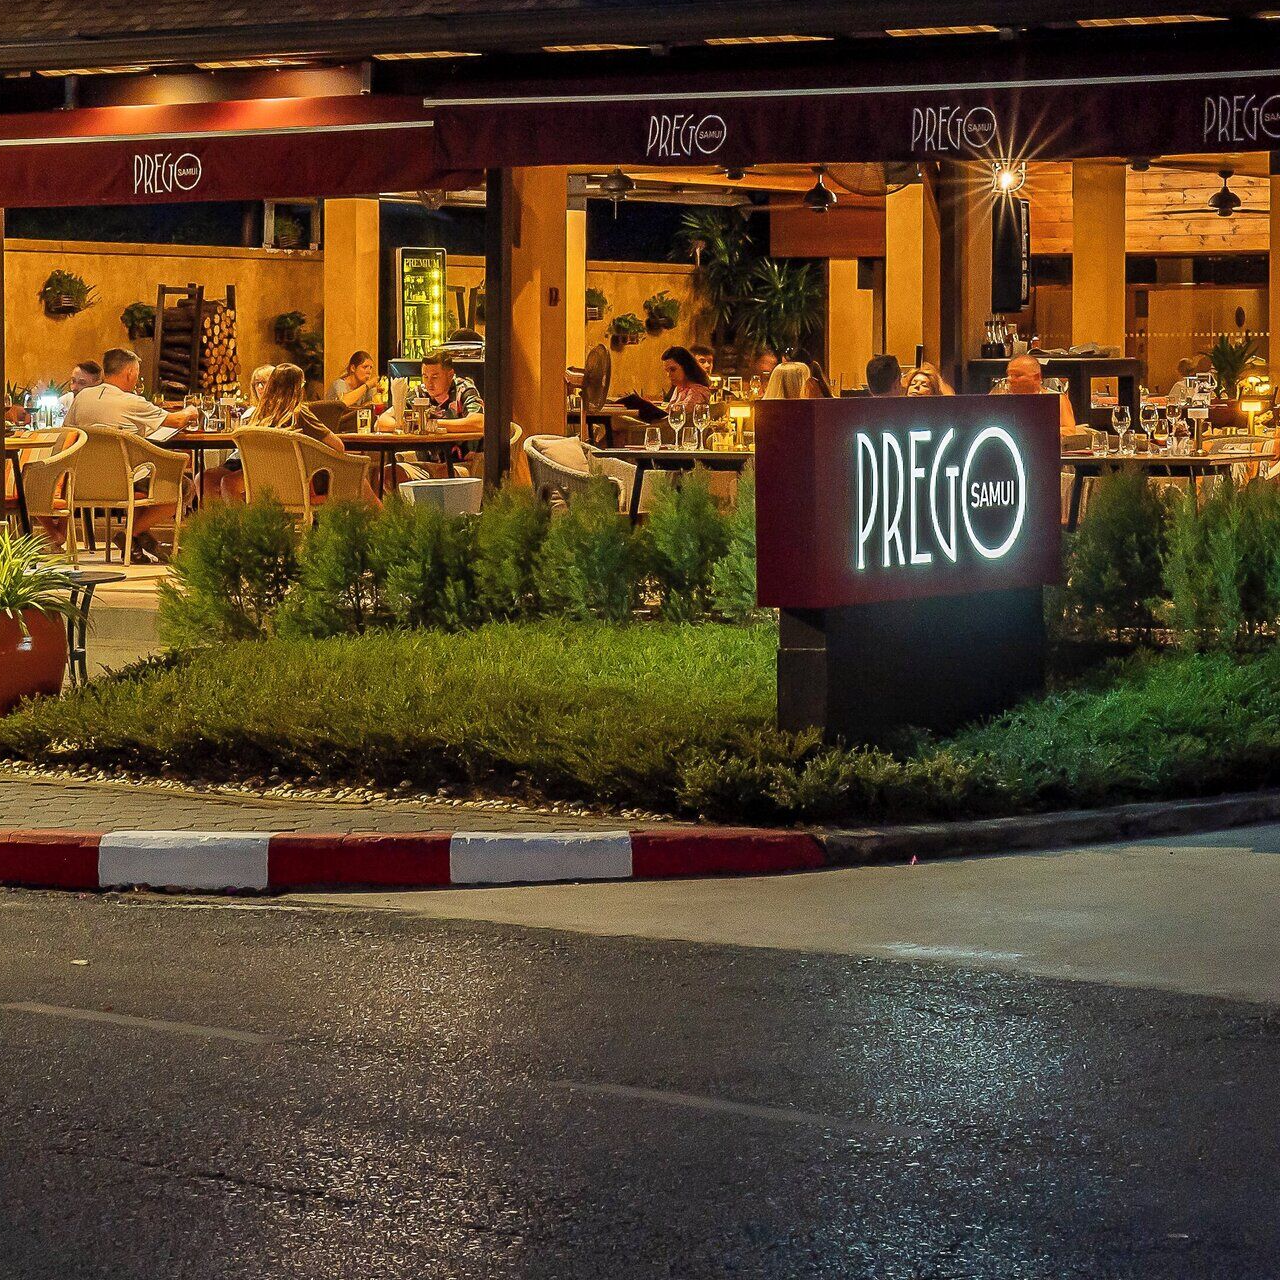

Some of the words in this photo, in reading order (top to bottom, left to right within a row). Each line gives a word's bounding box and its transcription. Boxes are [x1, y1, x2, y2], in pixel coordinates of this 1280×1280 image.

[646, 114, 727, 156] PREGO
[699, 130, 723, 139] SAMUI
[911, 106, 997, 151] PREGO
[967, 123, 992, 132] SAMUI
[134, 153, 202, 194] PREGO
[177, 167, 198, 176] SAMUI
[404, 258, 440, 268] PREMIUM
[856, 426, 1026, 570] PREGO
[971, 480, 1015, 508] SAMUI
